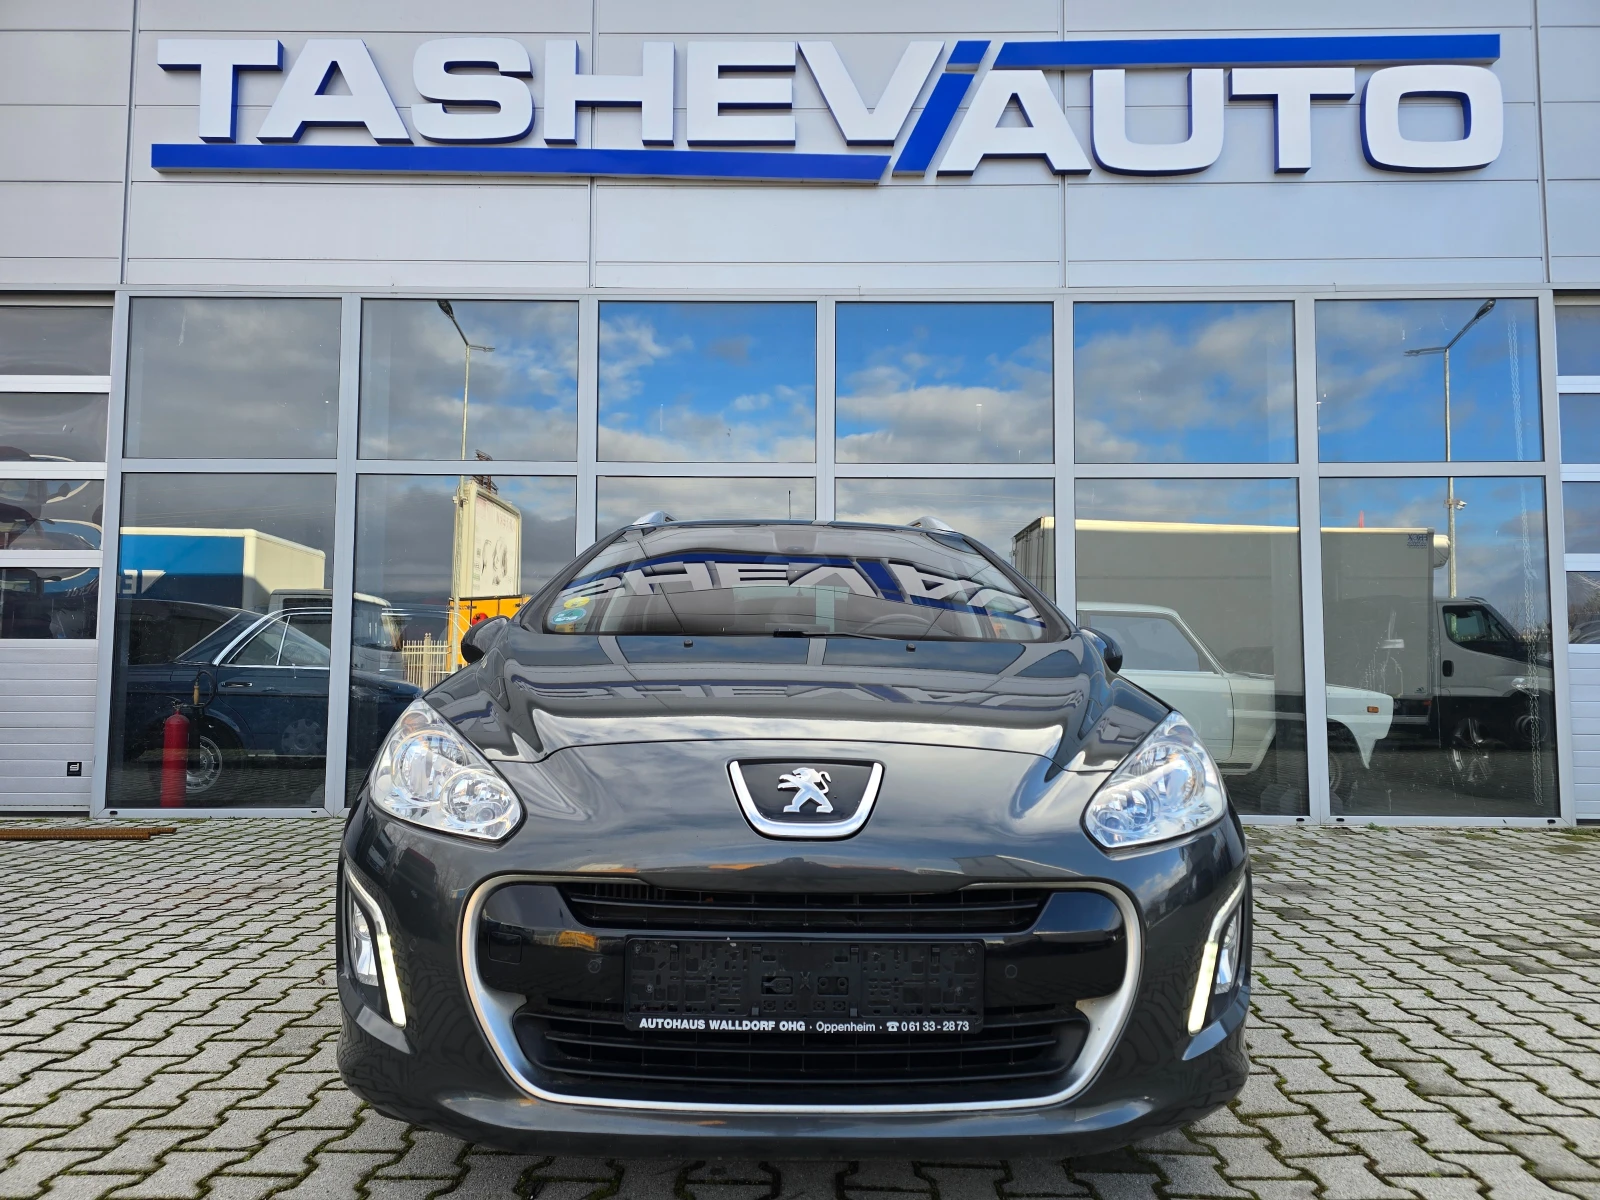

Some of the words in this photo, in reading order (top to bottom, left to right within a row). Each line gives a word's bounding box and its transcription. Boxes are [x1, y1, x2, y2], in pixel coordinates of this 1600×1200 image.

[157, 37, 945, 147] TASHEV
[937, 64, 1504, 176] AUTO
[639, 1018, 706, 1030] AUTOHAUS
[709, 1019, 776, 1031] WALLDORF
[779, 1021, 806, 1031] OHG
[816, 1021, 876, 1033] Oppenheim
